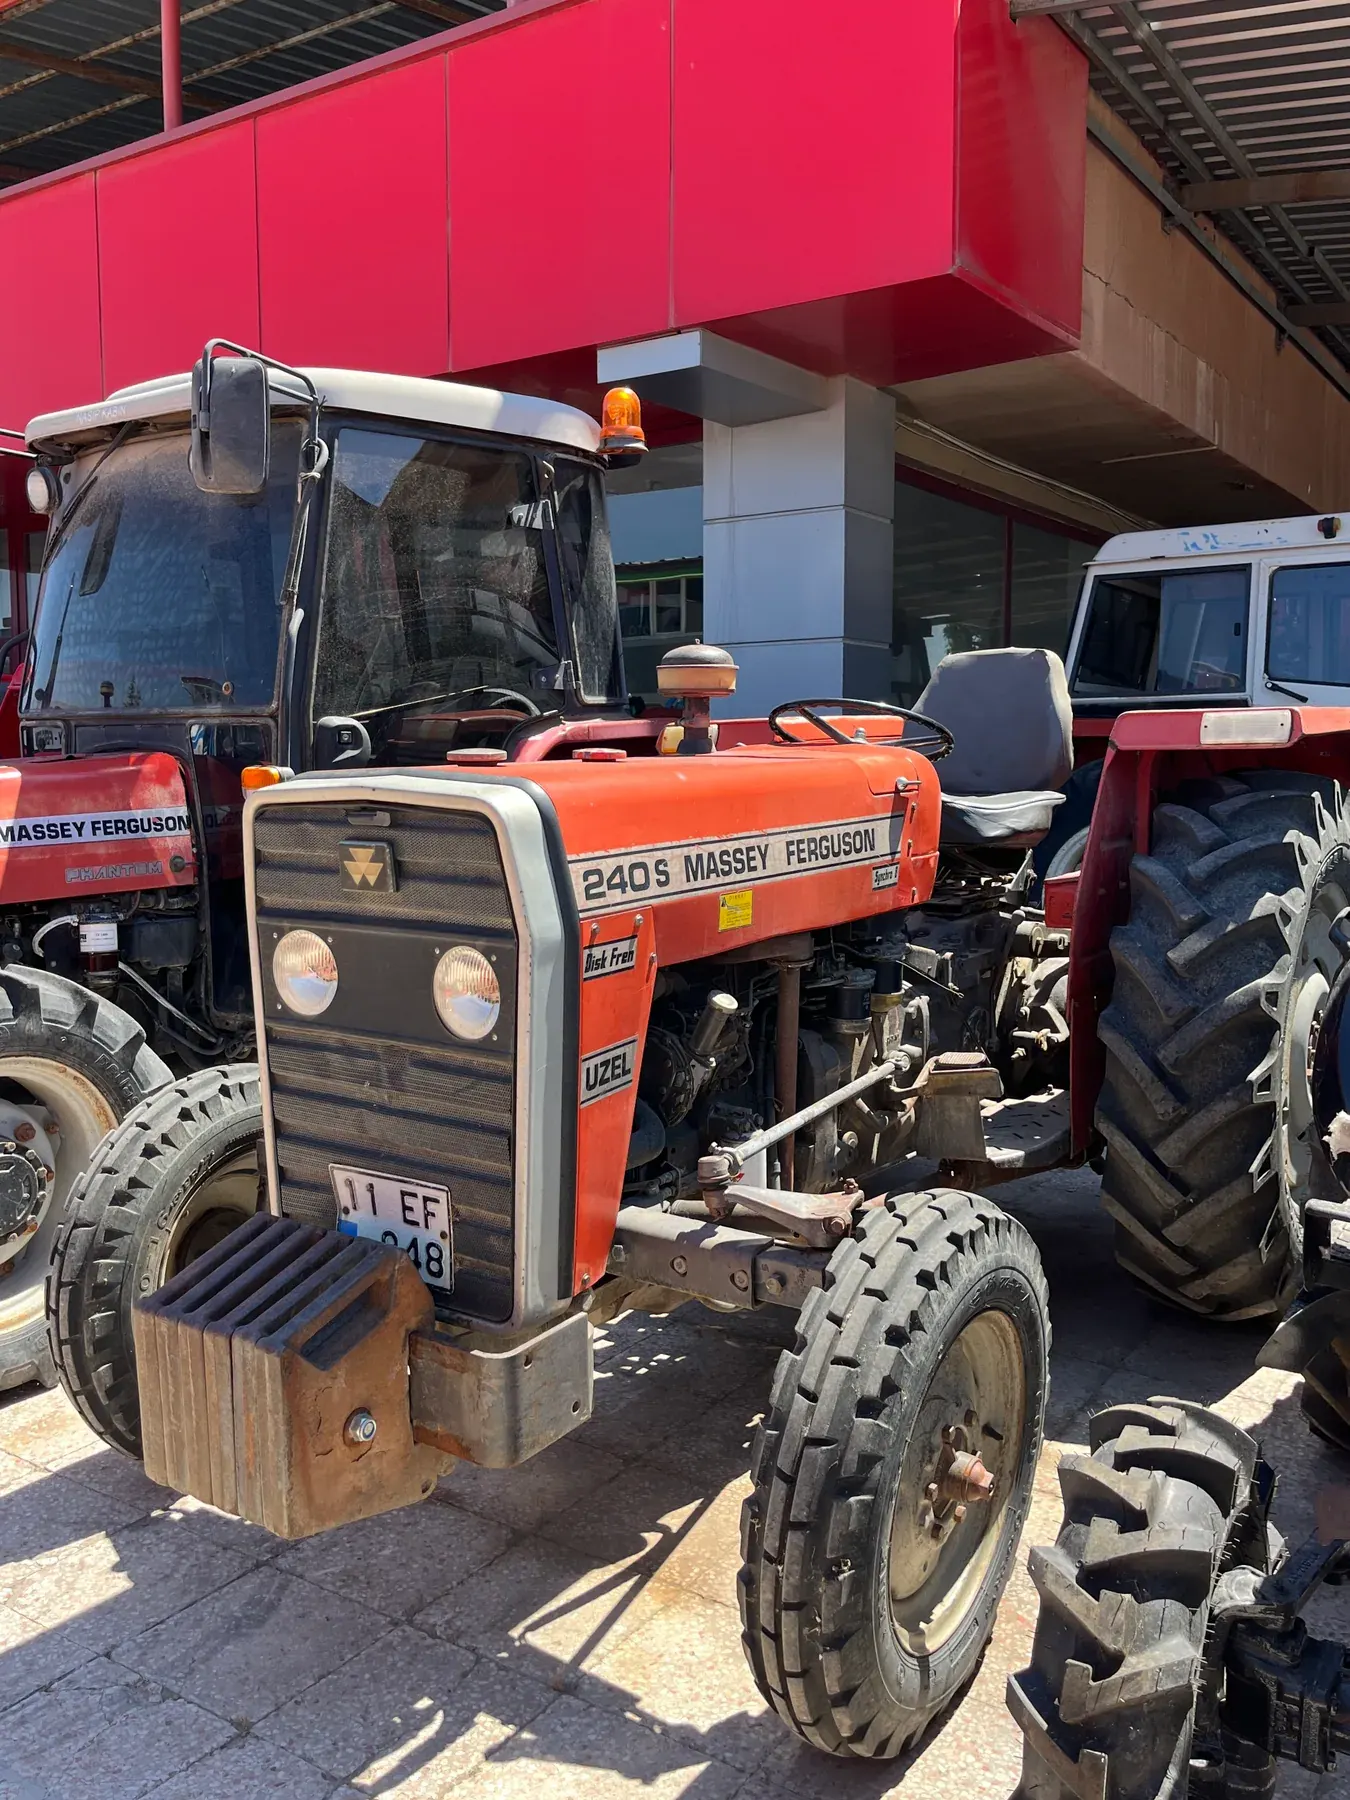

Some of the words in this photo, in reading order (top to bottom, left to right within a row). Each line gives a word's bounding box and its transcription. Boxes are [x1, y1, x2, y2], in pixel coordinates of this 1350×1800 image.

[0, 821, 85, 842] MASSEY
[90, 815, 191, 836] FERGUSON
[65, 861, 163, 883] PHANTOM
[684, 844, 769, 883] MASSEY
[786, 828, 876, 866] FERGUSON
[584, 950, 607, 974] Disk
[610, 947, 635, 967] Fren
[586, 1052, 631, 1091] UZEL
[344, 1178, 377, 1216] 11
[400, 1189, 440, 1230] EF
